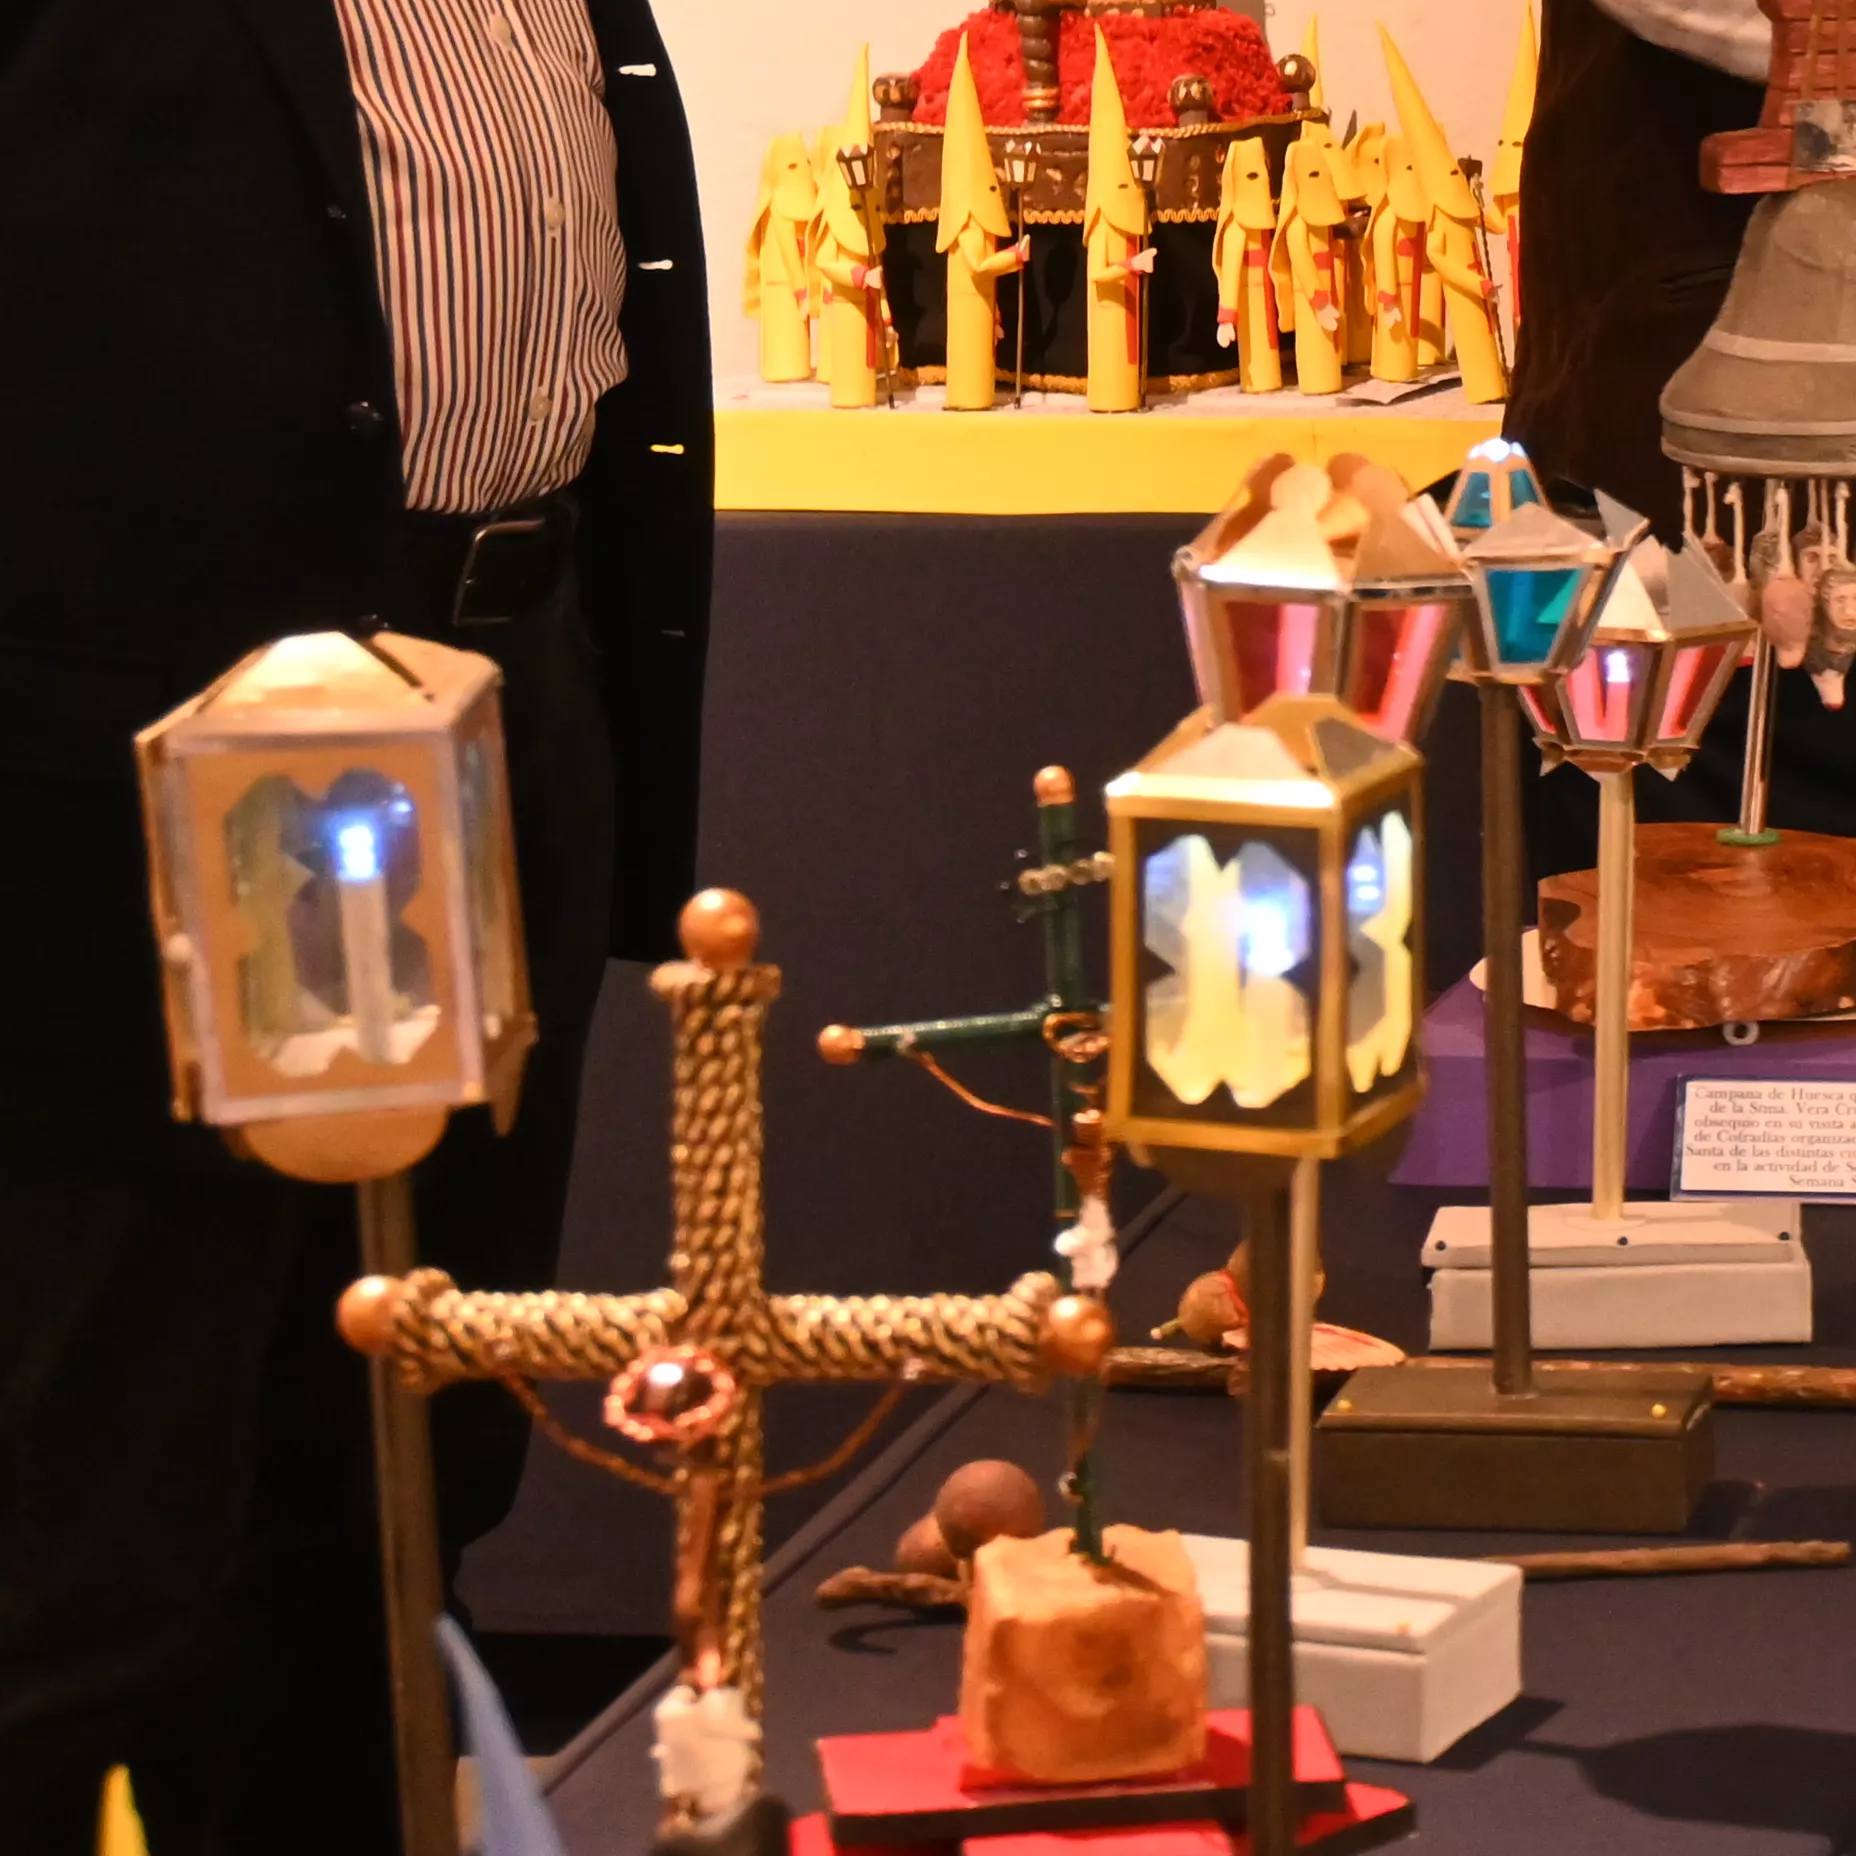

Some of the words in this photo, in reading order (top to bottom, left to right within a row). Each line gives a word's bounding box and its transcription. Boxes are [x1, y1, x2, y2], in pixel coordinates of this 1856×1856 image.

[1695, 1087, 1762, 1102] Campana
[1768, 1088, 1783, 1100] de
[1791, 1088, 1844, 1100] Huesca
[1709, 1101, 1727, 1114] de
[1732, 1101, 1743, 1114] la
[1796, 1102, 1829, 1115] Vera
[1694, 1116, 1760, 1129] obsequio
[1765, 1120, 1783, 1128] en
[1788, 1120, 1803, 1129] su
[1808, 1118, 1844, 1129] visita
[1849, 1122, 1856, 1130] a
[1693, 1130, 1711, 1142] de
[1686, 1145, 1724, 1157] Santa
[1729, 1145, 1747, 1157] de
[1752, 1145, 1770, 1157] las
[1776, 1146, 1834, 1158] distintas
[1713, 1162, 1731, 1171] en
[1737, 1159, 1748, 1171] la
[1754, 1161, 1817, 1172] actividad
[1823, 1161, 1839, 1173] de
[1789, 1175, 1845, 1187] Semana
